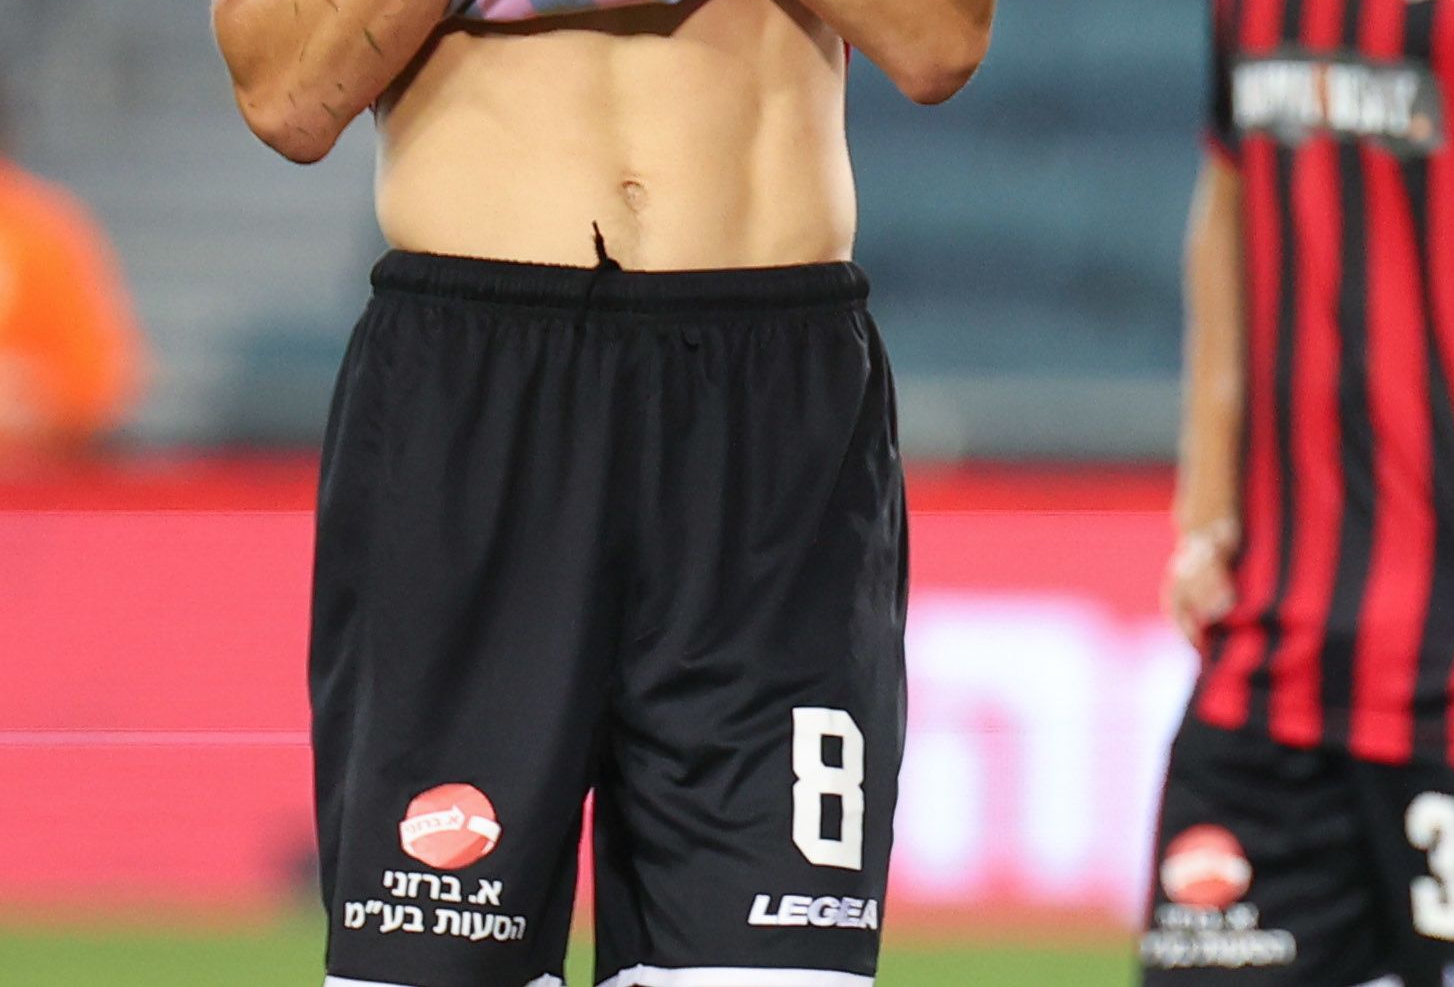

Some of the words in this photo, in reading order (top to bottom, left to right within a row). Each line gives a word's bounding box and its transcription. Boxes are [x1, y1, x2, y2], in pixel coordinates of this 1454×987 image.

[791, 706, 865, 871] 8
[383, 870, 462, 903] ברזני
[468, 879, 503, 906] א.
[432, 907, 526, 942] הסעות
[747, 894, 878, 930] LEGEA
